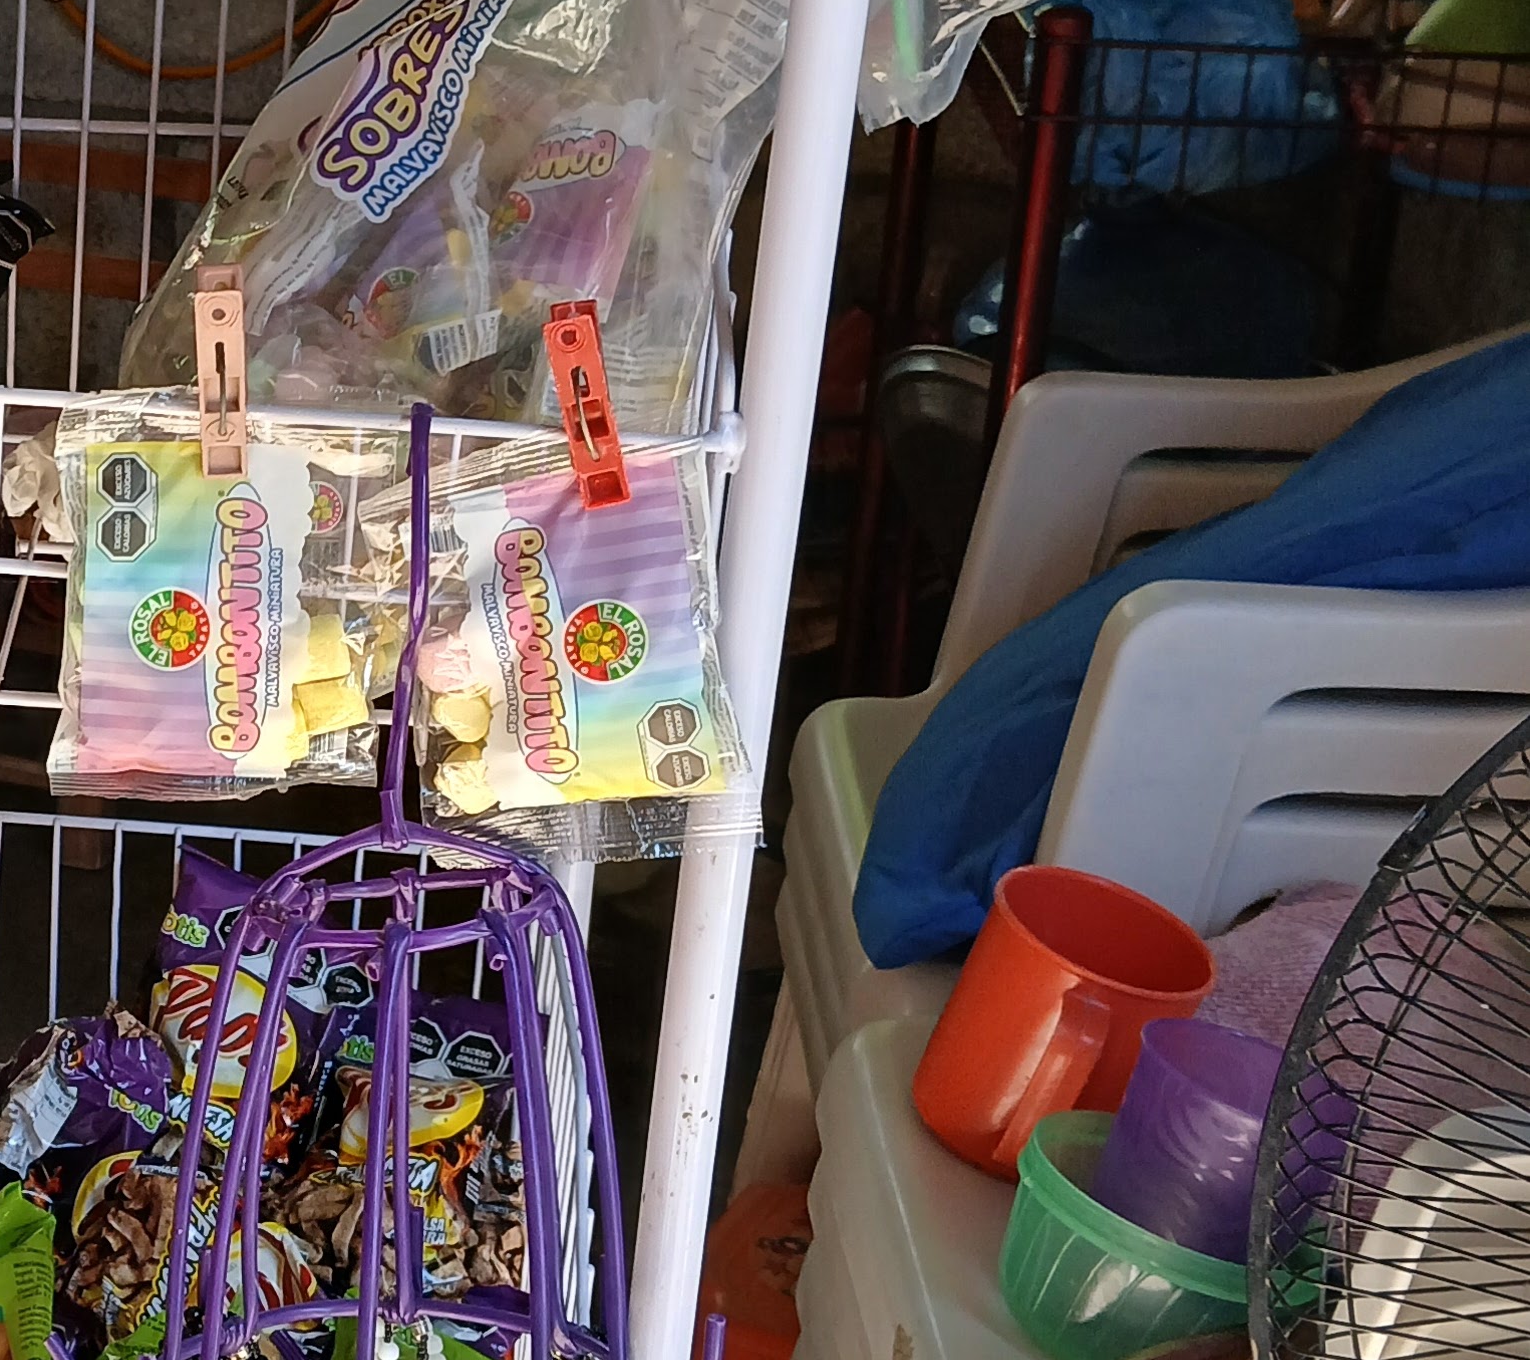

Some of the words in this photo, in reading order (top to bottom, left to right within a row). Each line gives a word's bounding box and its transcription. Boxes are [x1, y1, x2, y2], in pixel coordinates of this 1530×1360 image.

[321, 1, 471, 187] SOBRES
[133, 590, 171, 646] ROSAL
[601, 603, 623, 621] EL
[154, 648, 169, 667] EL
[610, 621, 645, 680] ROSAL
